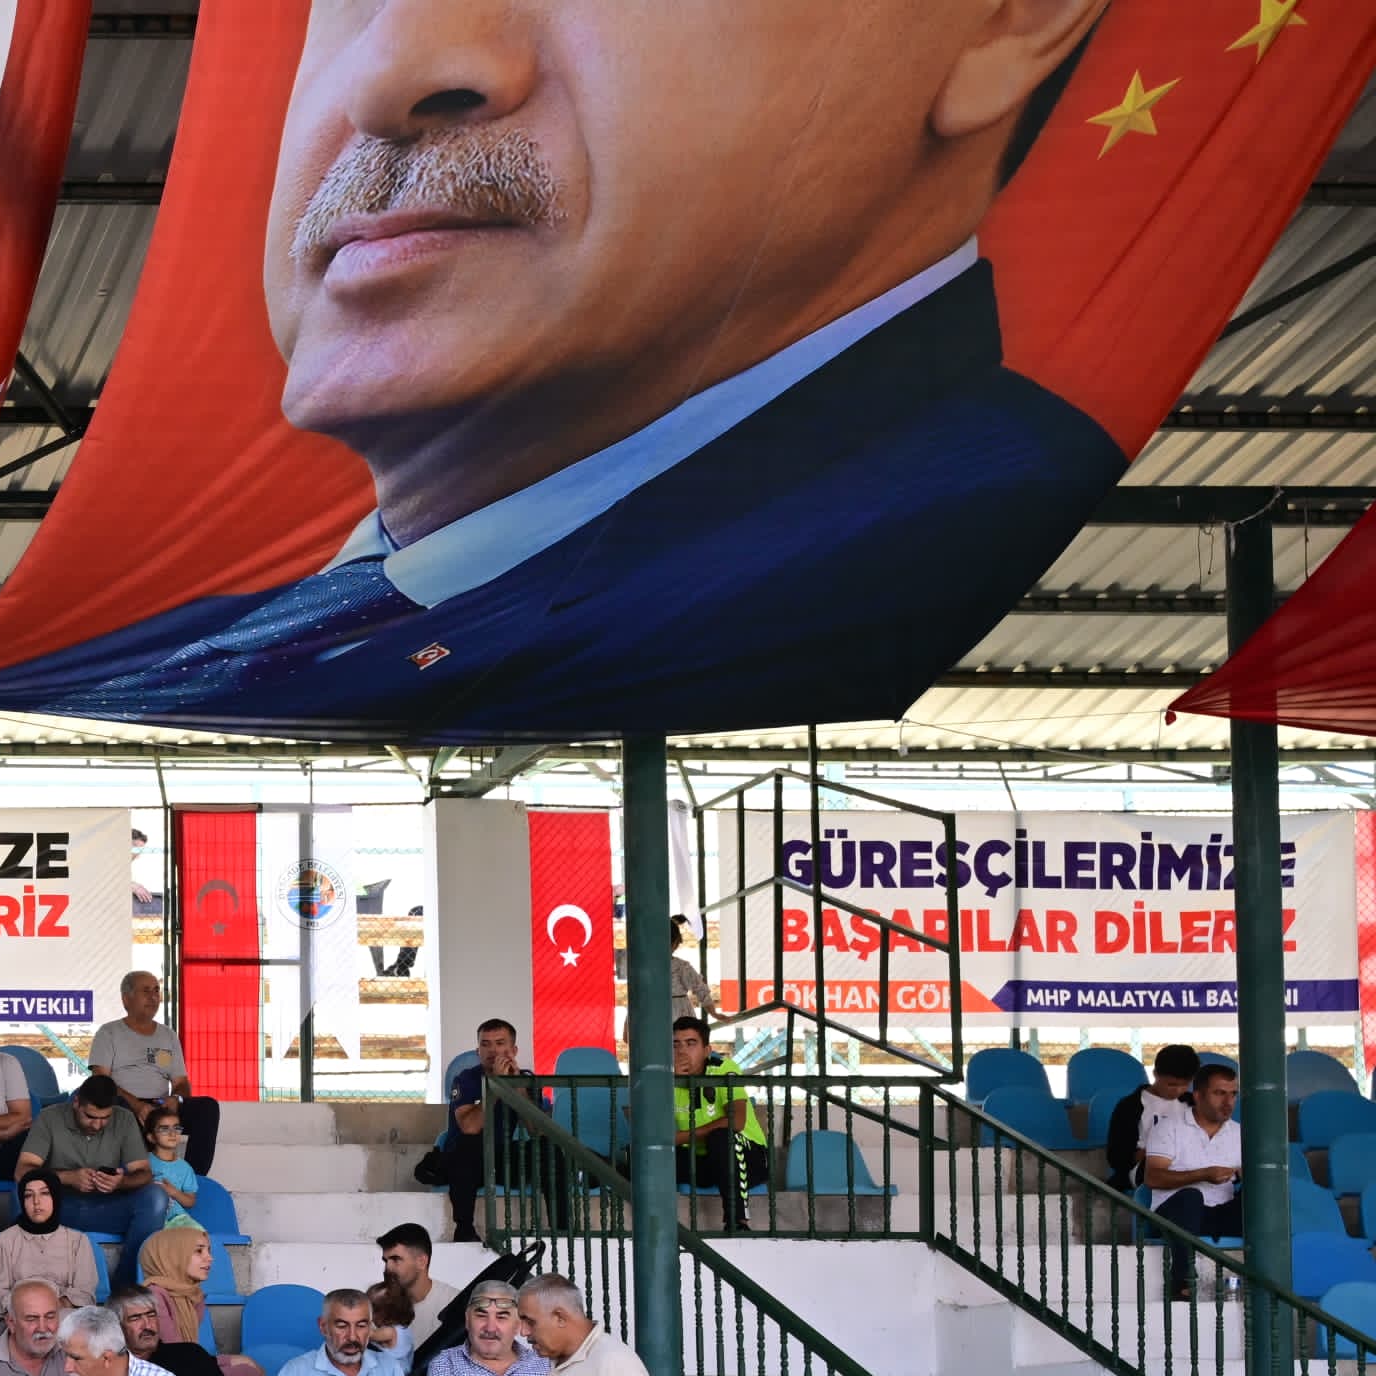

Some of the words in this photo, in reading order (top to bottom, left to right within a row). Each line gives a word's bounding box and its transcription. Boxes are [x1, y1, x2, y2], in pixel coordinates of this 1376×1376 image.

[782, 908, 1079, 961] BAŞARILAR
[1094, 900, 1297, 954] DİLERZ
[1026, 989, 1071, 1007] MHP
[1077, 990, 1176, 1008] MALATYA
